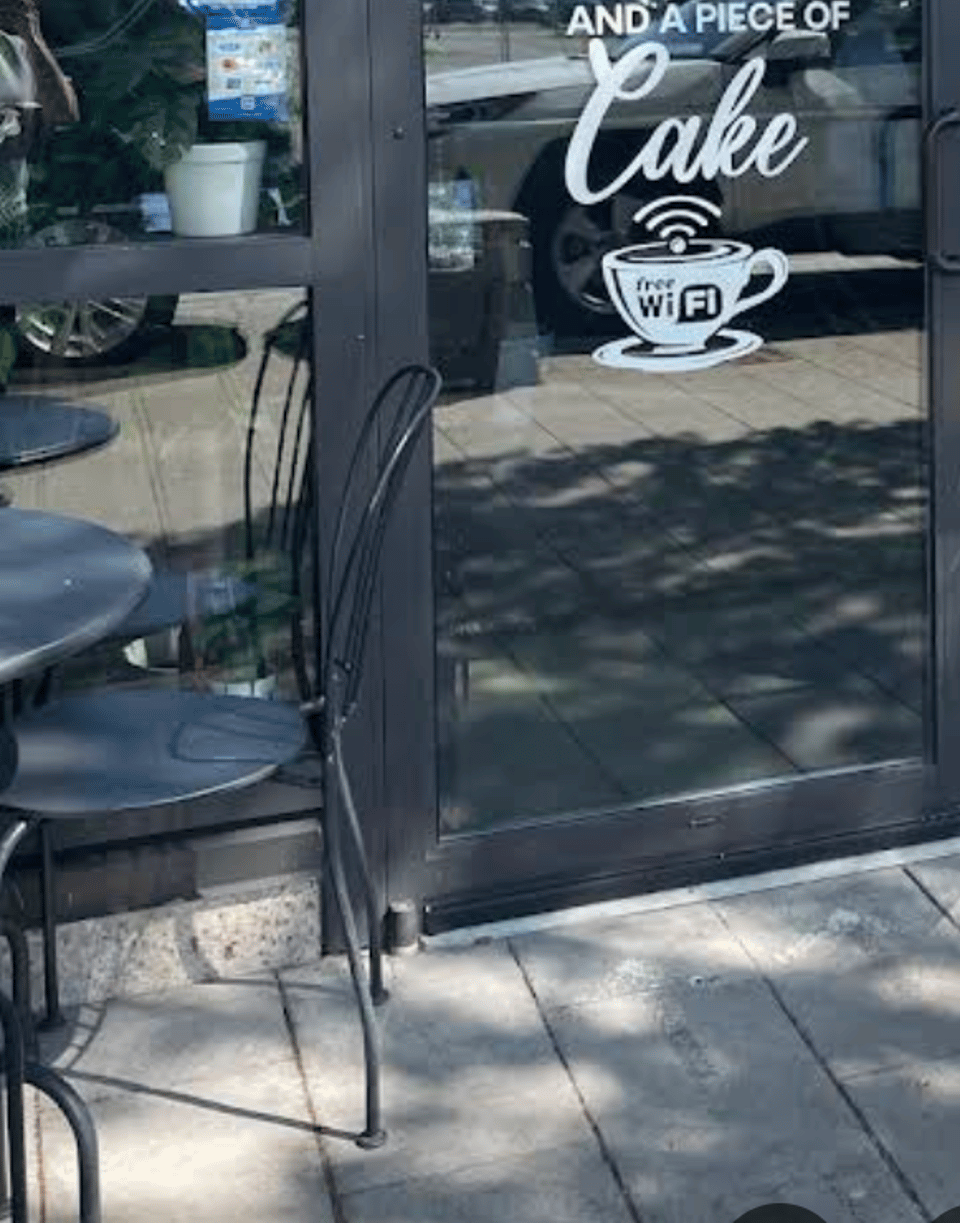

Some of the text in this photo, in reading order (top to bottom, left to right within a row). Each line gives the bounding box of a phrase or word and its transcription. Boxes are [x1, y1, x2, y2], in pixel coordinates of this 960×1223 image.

[566, 0, 851, 36] AND A PIECE OF
[564, 38, 810, 206] Cake
